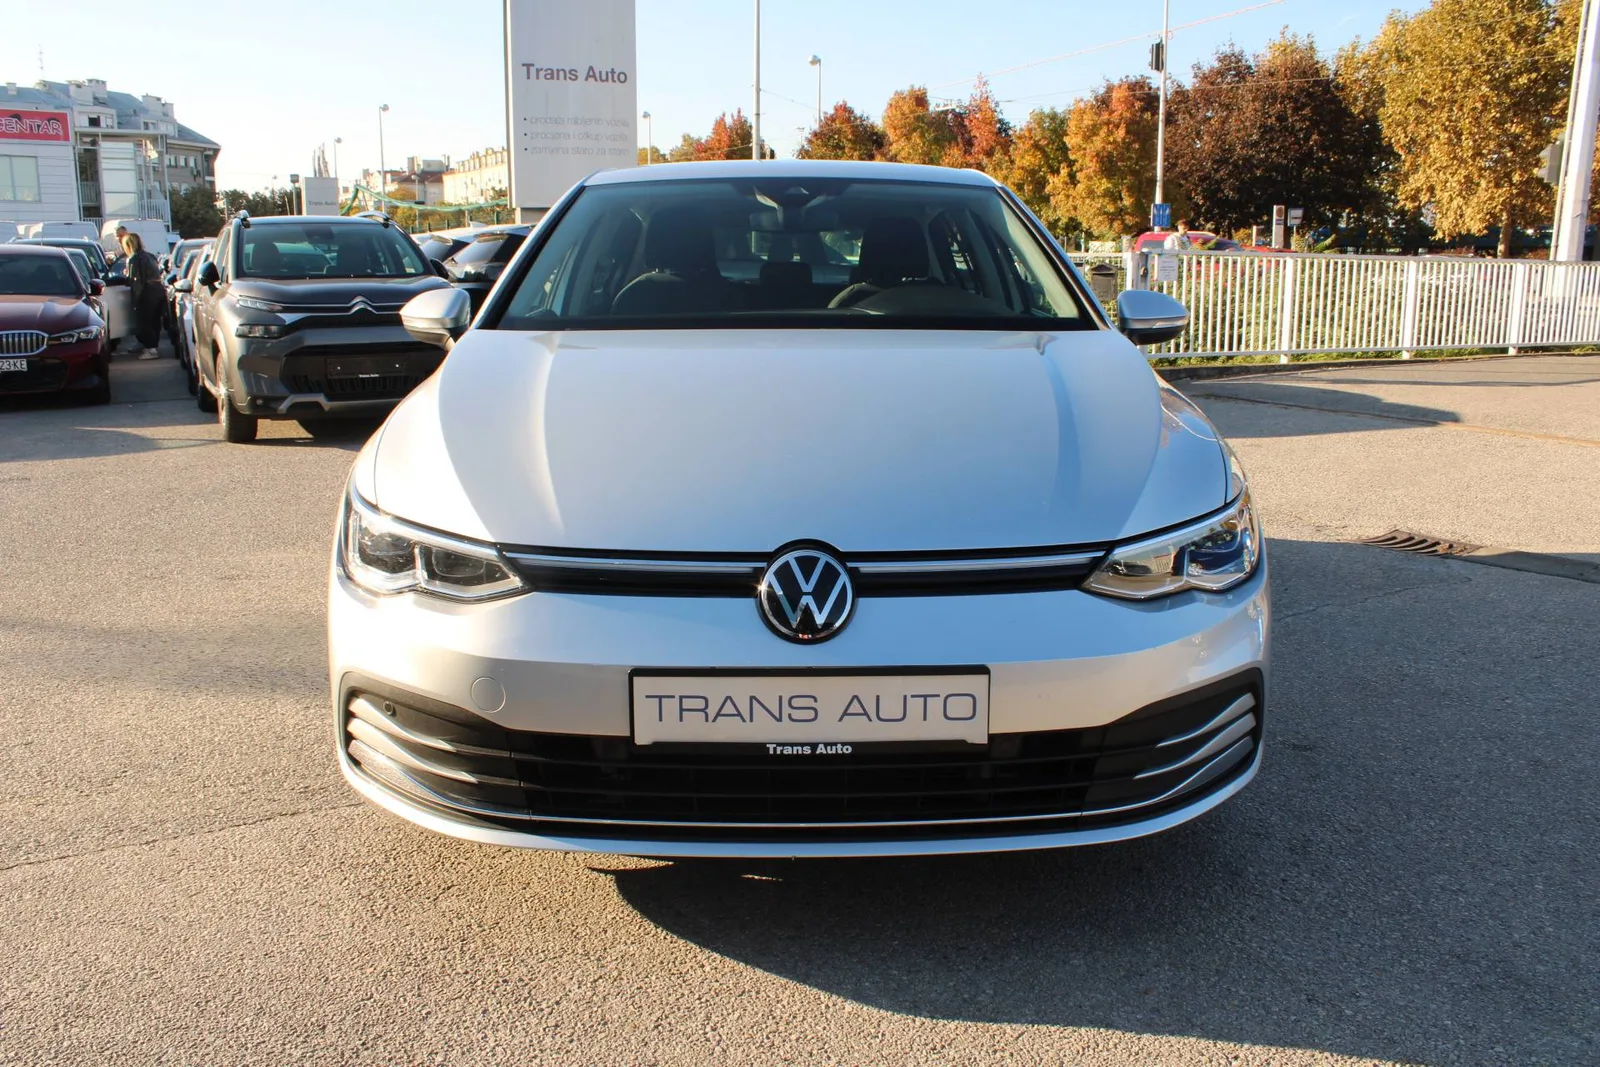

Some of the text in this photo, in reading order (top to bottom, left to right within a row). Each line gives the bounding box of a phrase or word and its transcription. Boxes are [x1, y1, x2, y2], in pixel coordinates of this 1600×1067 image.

[521, 63, 628, 83] Trans Auto
[645, 693, 977, 722] TRANS AUTO
[766, 743, 852, 755] Trans Auto
